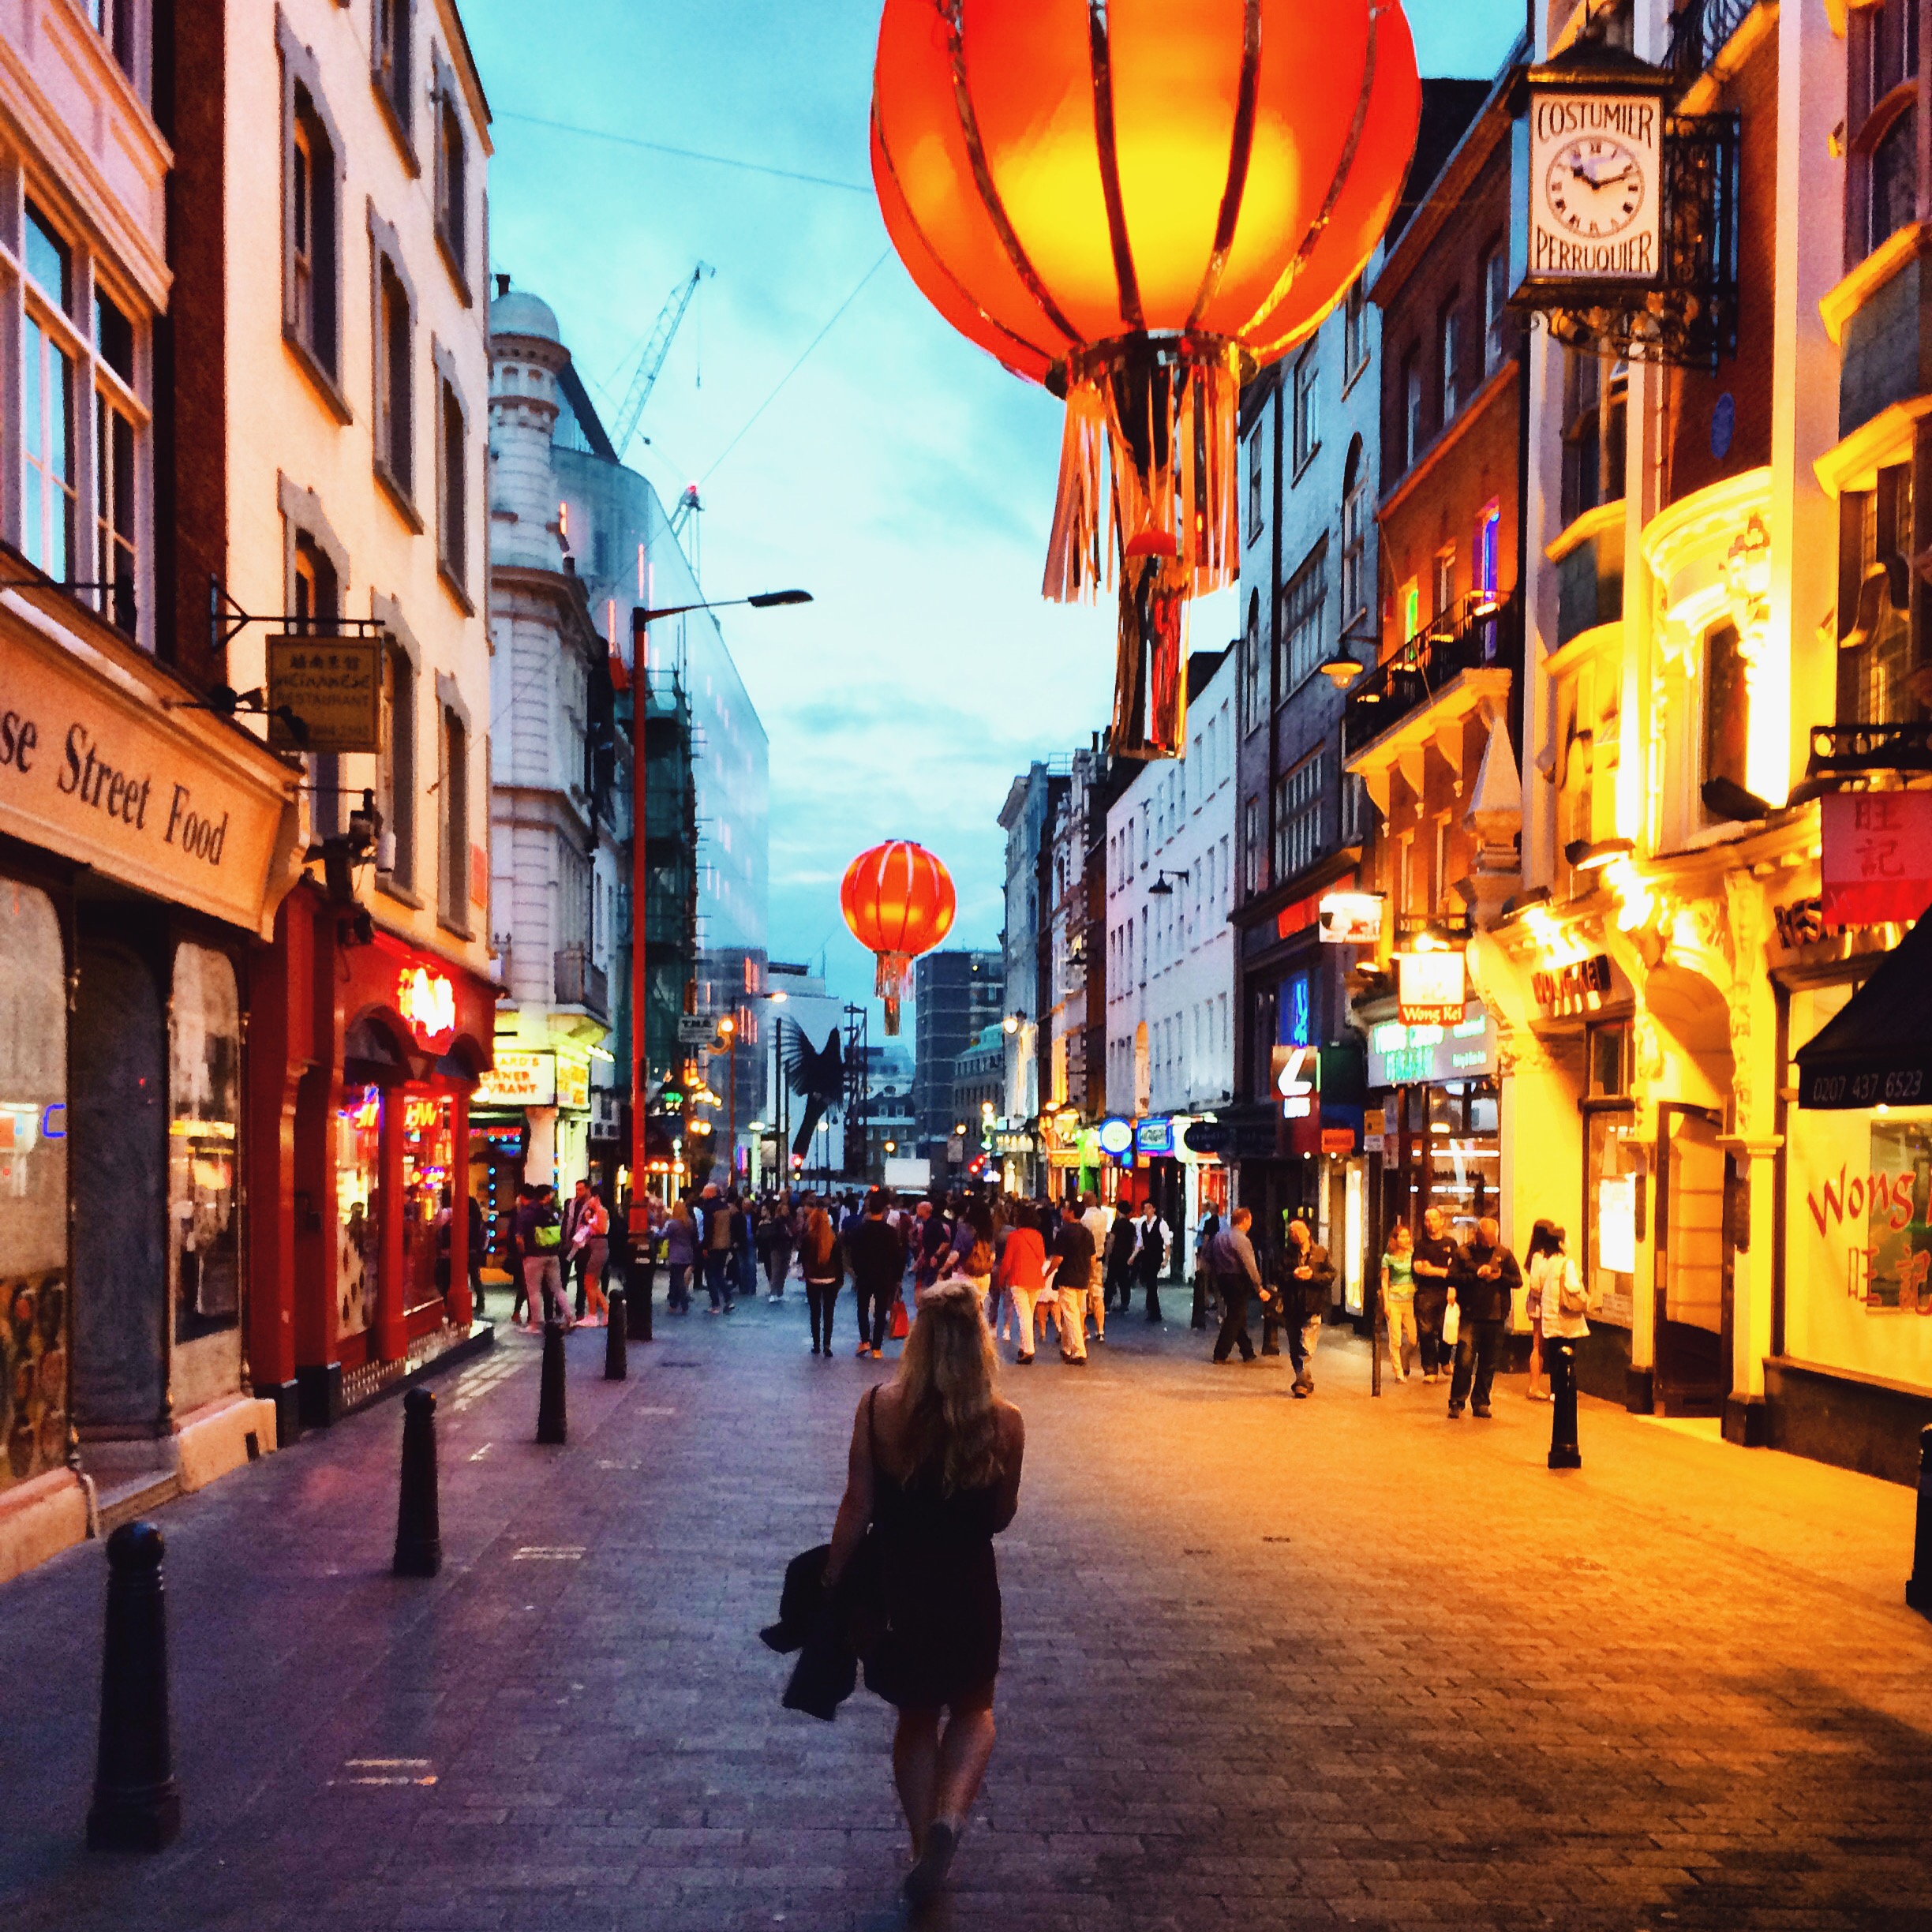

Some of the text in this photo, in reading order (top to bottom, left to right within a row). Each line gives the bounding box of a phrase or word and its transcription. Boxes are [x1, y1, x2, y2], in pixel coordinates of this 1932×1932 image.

[1537, 100, 1653, 148] COSTUMIER
[0, 710, 229, 866] se Street Food
[1402, 1006, 1440, 1024] Wong
[481, 1070, 530, 1082] ORNER
[1814, 1069, 1923, 1102] 0207 437 6523
[1807, 1163, 1916, 1237] Wong
